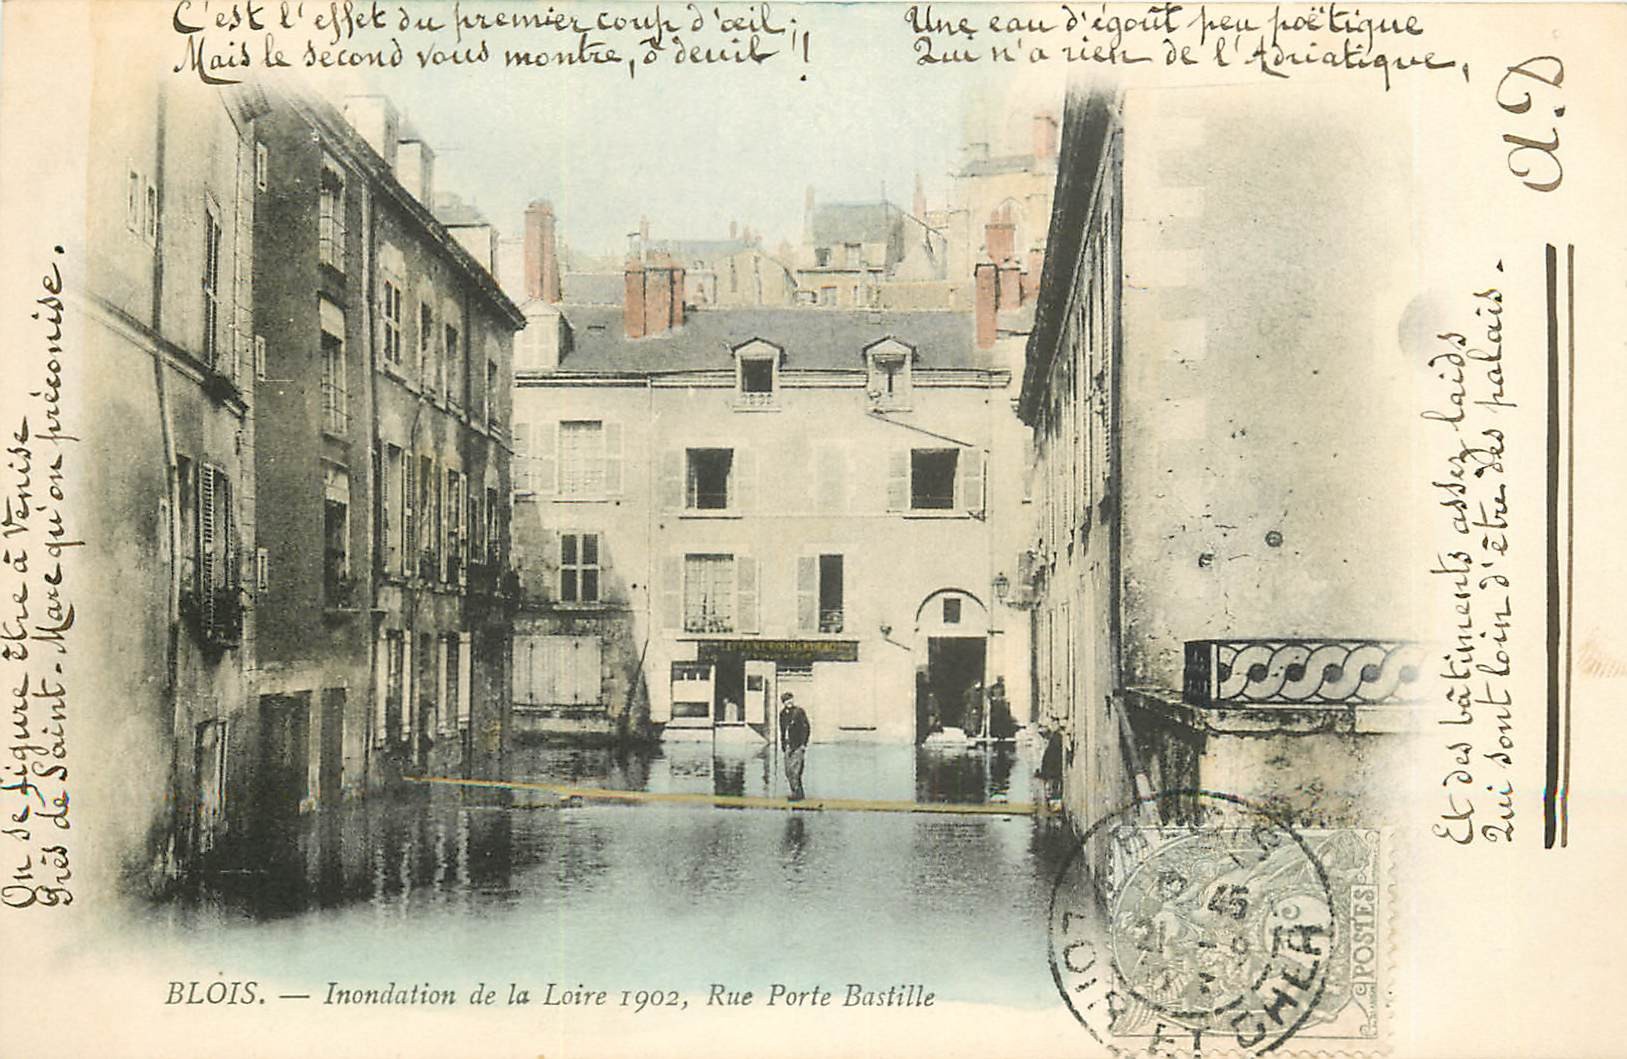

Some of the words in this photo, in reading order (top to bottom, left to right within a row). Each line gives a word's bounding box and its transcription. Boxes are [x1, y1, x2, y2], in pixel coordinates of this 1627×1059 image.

[173, 1, 265, 34] C'est
[280, 2, 386, 45] l'effet
[398, 7, 445, 31] du
[454, 2, 592, 43] premier
[598, 5, 679, 50] coup
[904, 6, 978, 35] Une
[989, 16, 1058, 33] eau
[1188, 5, 1260, 46] peu
[914, 36, 981, 65] Qui
[991, 38, 1049, 63] n'a
[1062, 36, 1152, 64] rien
[1163, 38, 1198, 65] de
[173, 34, 250, 85] Mais
[264, 33, 292, 67] le
[303, 39, 402, 67] second
[417, 40, 489, 68] vous
[2, 415, 32, 538] Venise
[1475, 596, 1512, 676] loin
[0, 672, 47, 806] figure
[1474, 681, 1514, 768] sont
[1443, 742, 1473, 786] des
[2, 805, 30, 841] se
[35, 790, 71, 829] de
[1431, 793, 1475, 845] Et
[1482, 779, 1515, 842] Qui
[1, 854, 36, 908] On
[1352, 889, 1376, 979] POSTES
